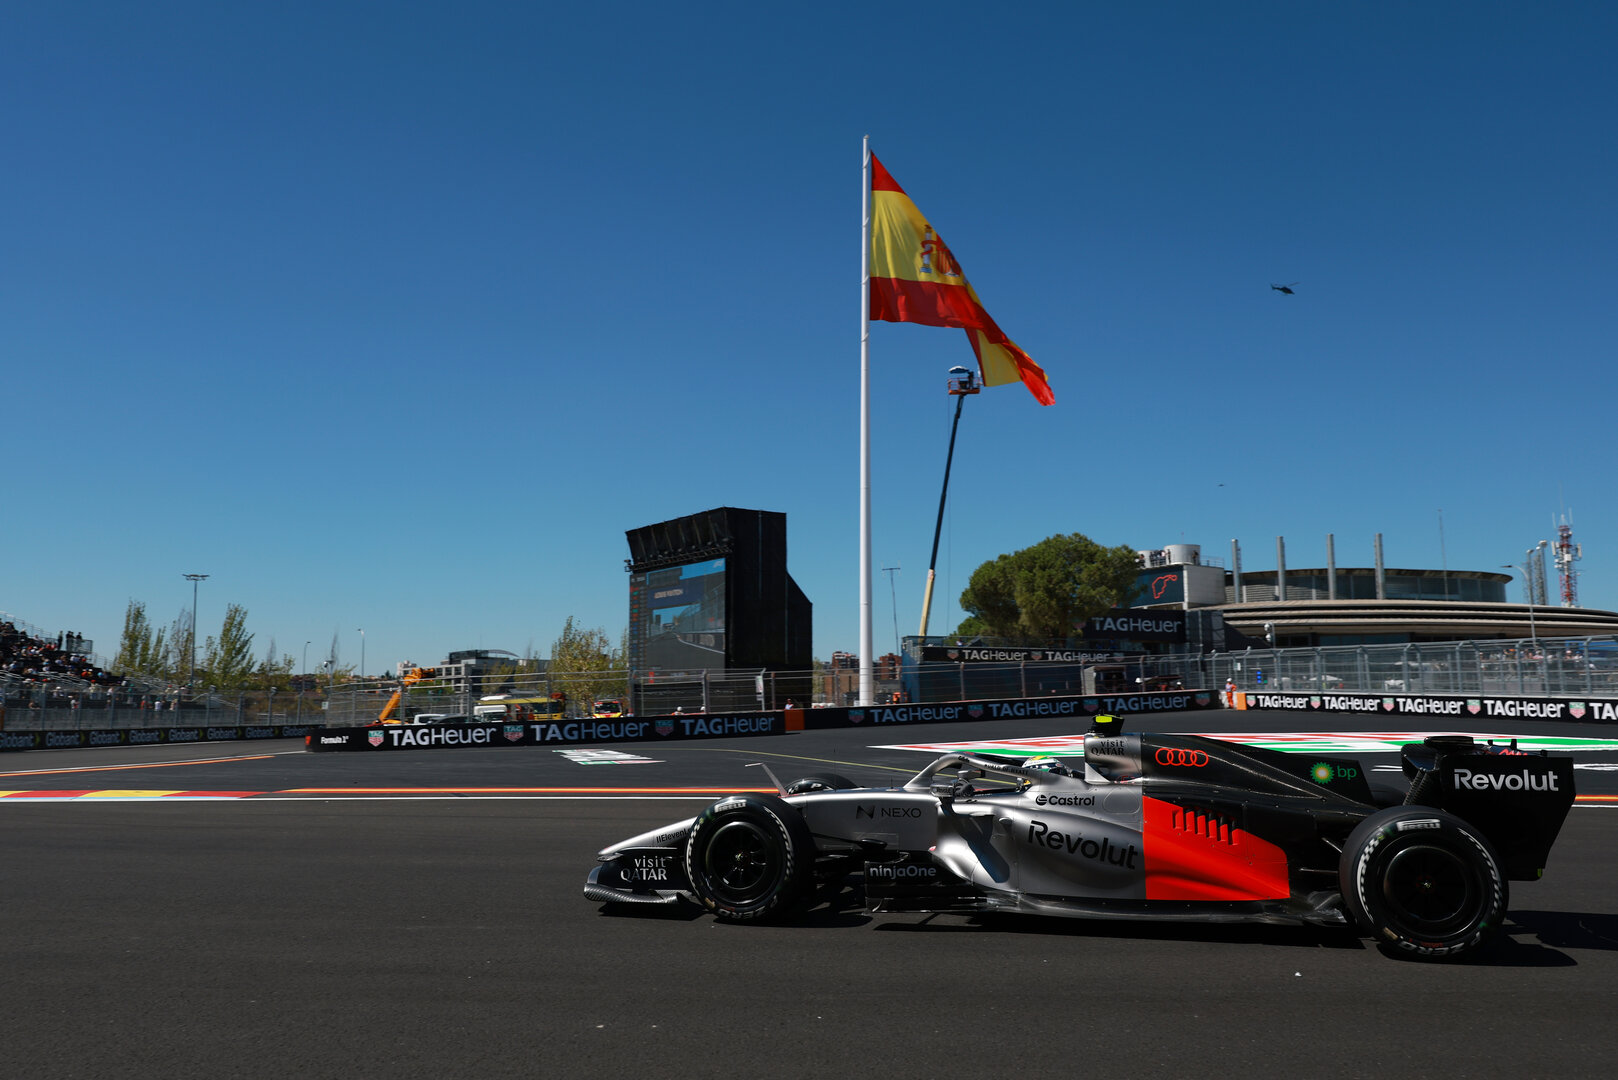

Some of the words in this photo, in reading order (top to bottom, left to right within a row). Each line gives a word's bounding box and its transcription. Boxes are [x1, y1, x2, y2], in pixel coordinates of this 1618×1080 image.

[1589, 702, 1618, 720] TA
[46, 732, 80, 747] Globant
[89, 730, 120, 745] Globant
[129, 729, 160, 743] Globant
[168, 728, 198, 742] Globant
[1100, 740, 1125, 748] visit
[1091, 748, 1124, 757] QATAR
[1337, 765, 1357, 780] bp
[1454, 768, 1559, 792] Revolut
[1048, 795, 1095, 806] Castrol
[881, 808, 922, 818] NEXO
[1028, 820, 1138, 870] Revolut
[634, 855, 666, 868] visit
[620, 868, 667, 882] QATAR
[869, 865, 936, 880] ninjaOne
